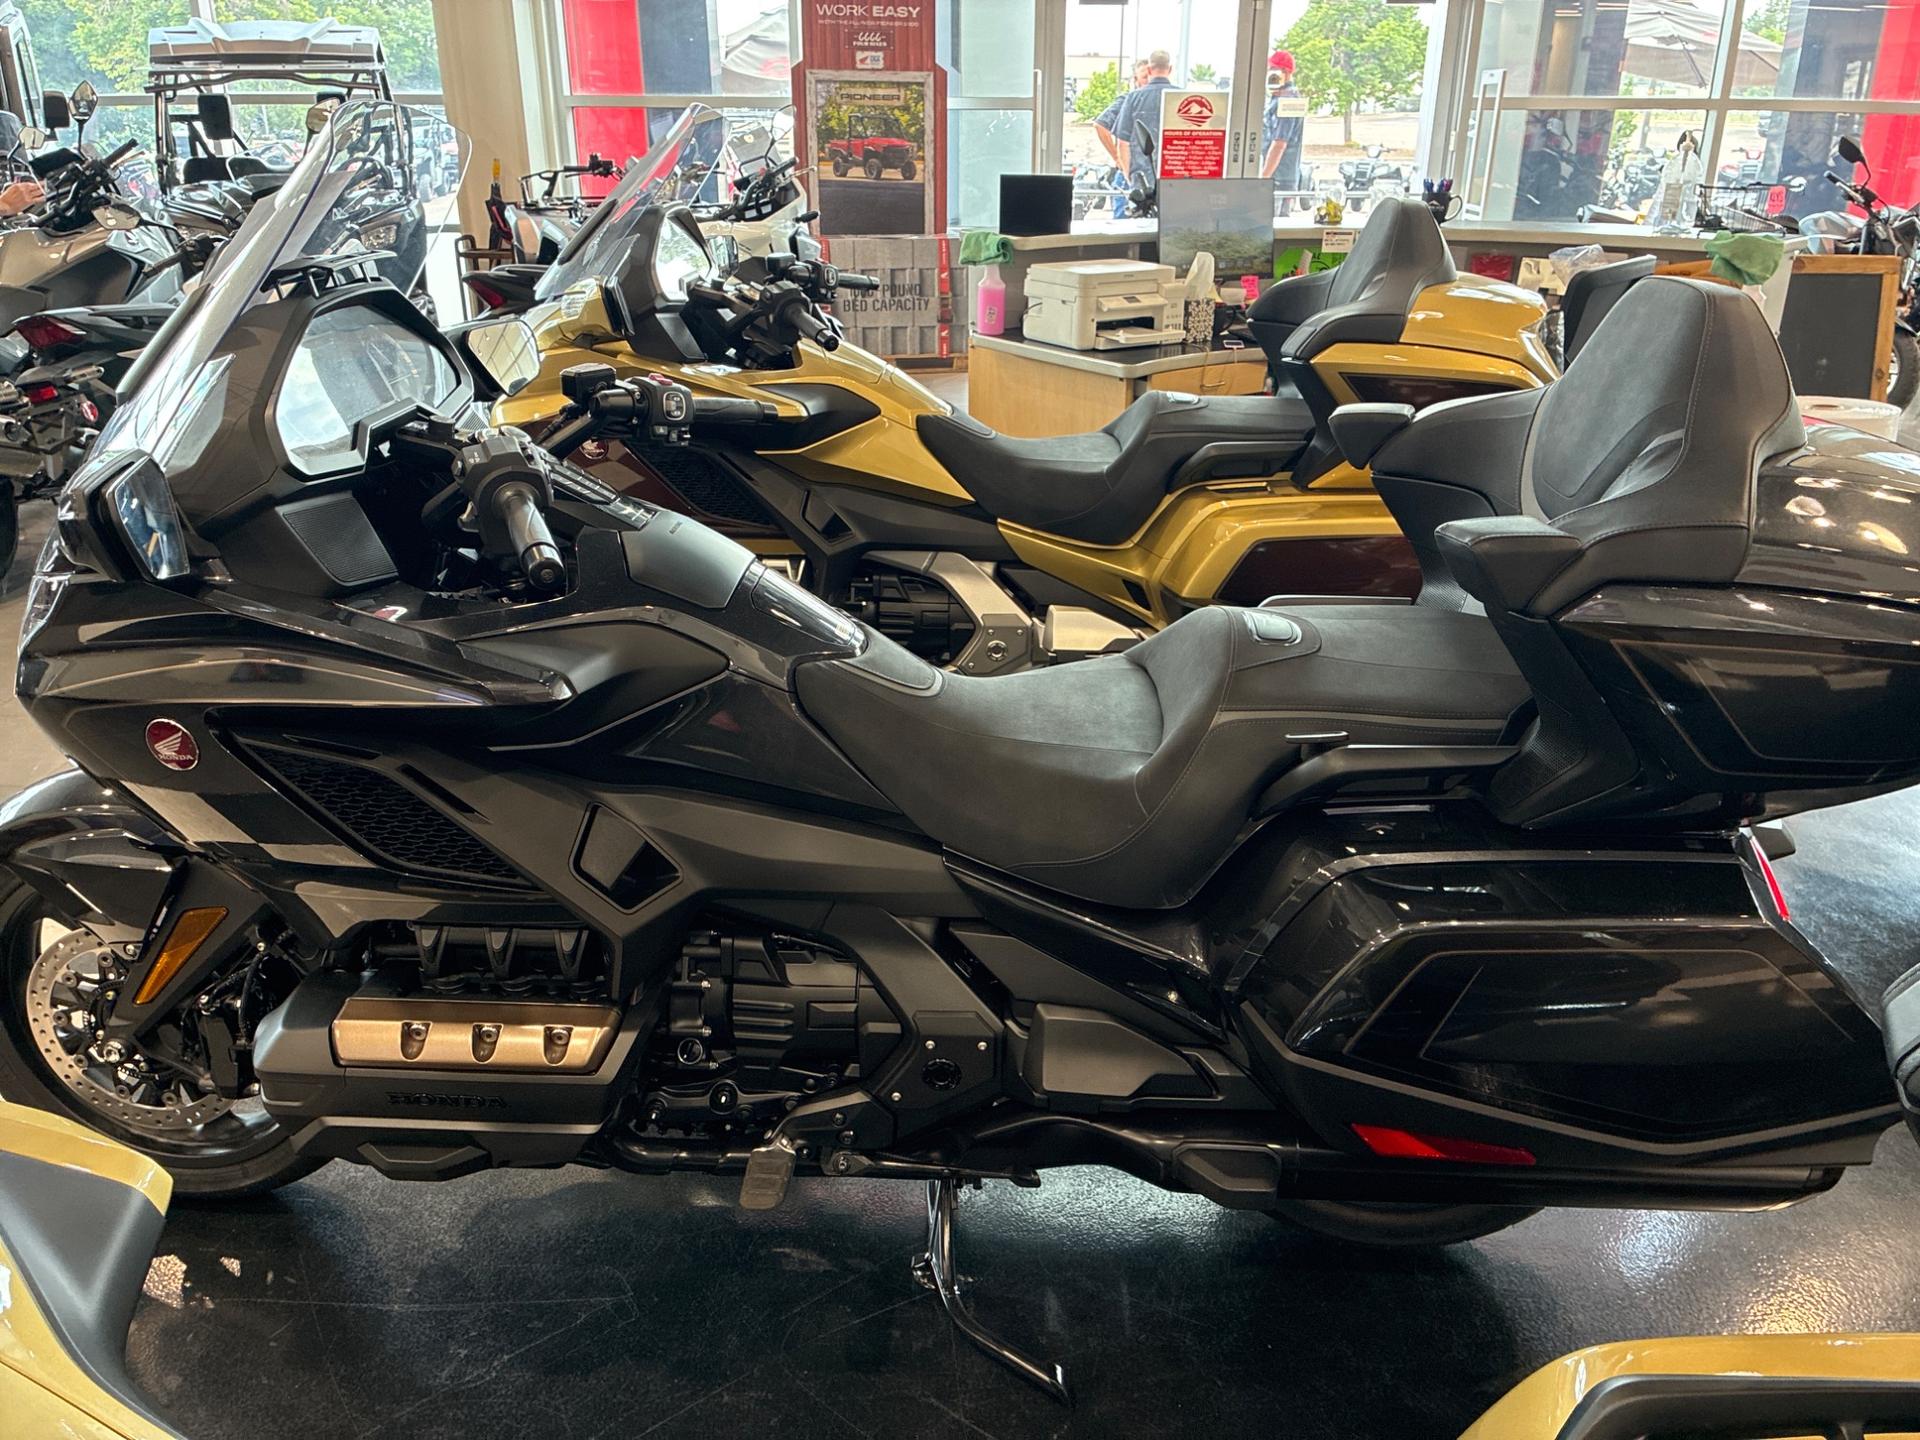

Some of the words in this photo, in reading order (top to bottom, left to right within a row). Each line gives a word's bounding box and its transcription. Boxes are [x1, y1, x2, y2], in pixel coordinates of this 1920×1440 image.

[816, 4, 868, 16] WORK
[872, 6, 920, 18] EASY
[882, 284, 921, 297] POUND
[844, 299, 868, 312] BED
[873, 298, 930, 312] CAPACITY
[386, 1092, 509, 1107] HONDA
